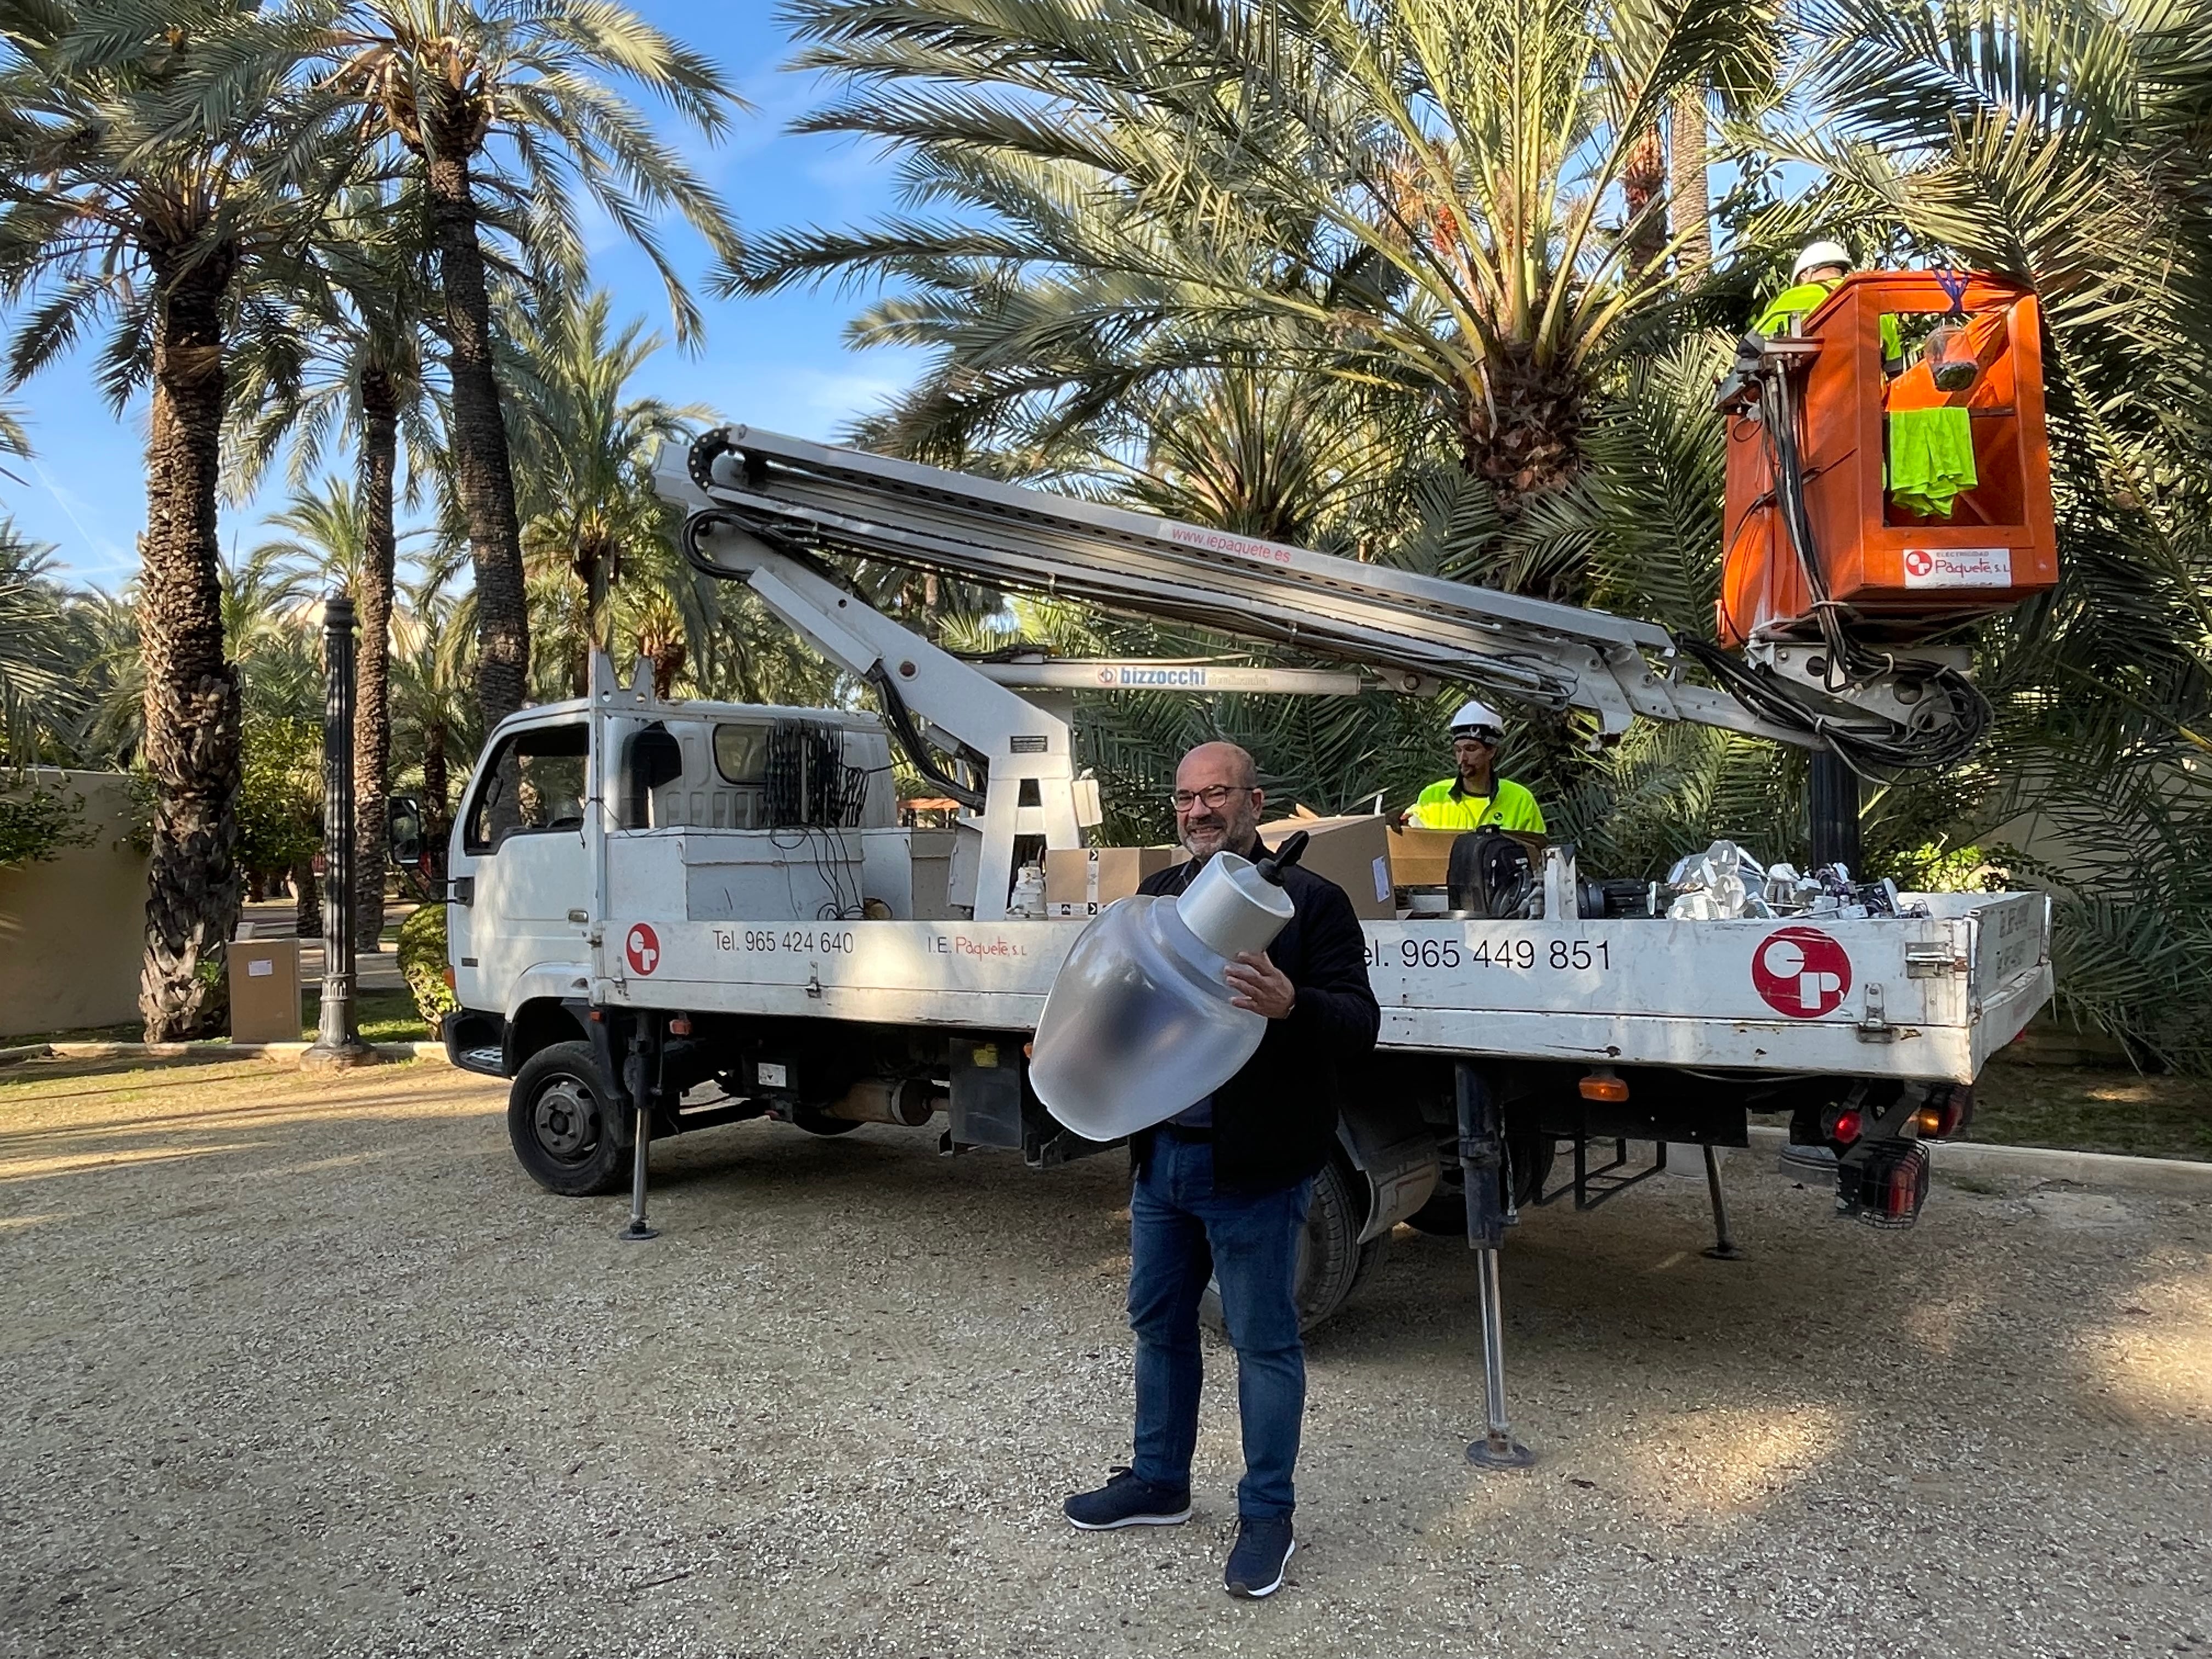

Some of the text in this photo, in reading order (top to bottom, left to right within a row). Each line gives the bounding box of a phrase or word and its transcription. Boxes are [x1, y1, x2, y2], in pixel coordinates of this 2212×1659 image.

[1172, 528, 1290, 563] www.iepaquetees
[1120, 667, 1206, 686] bizzocchi
[712, 930, 854, 953] Tel. 965 424 640
[1364, 939, 1610, 970] el. 965 449 851
